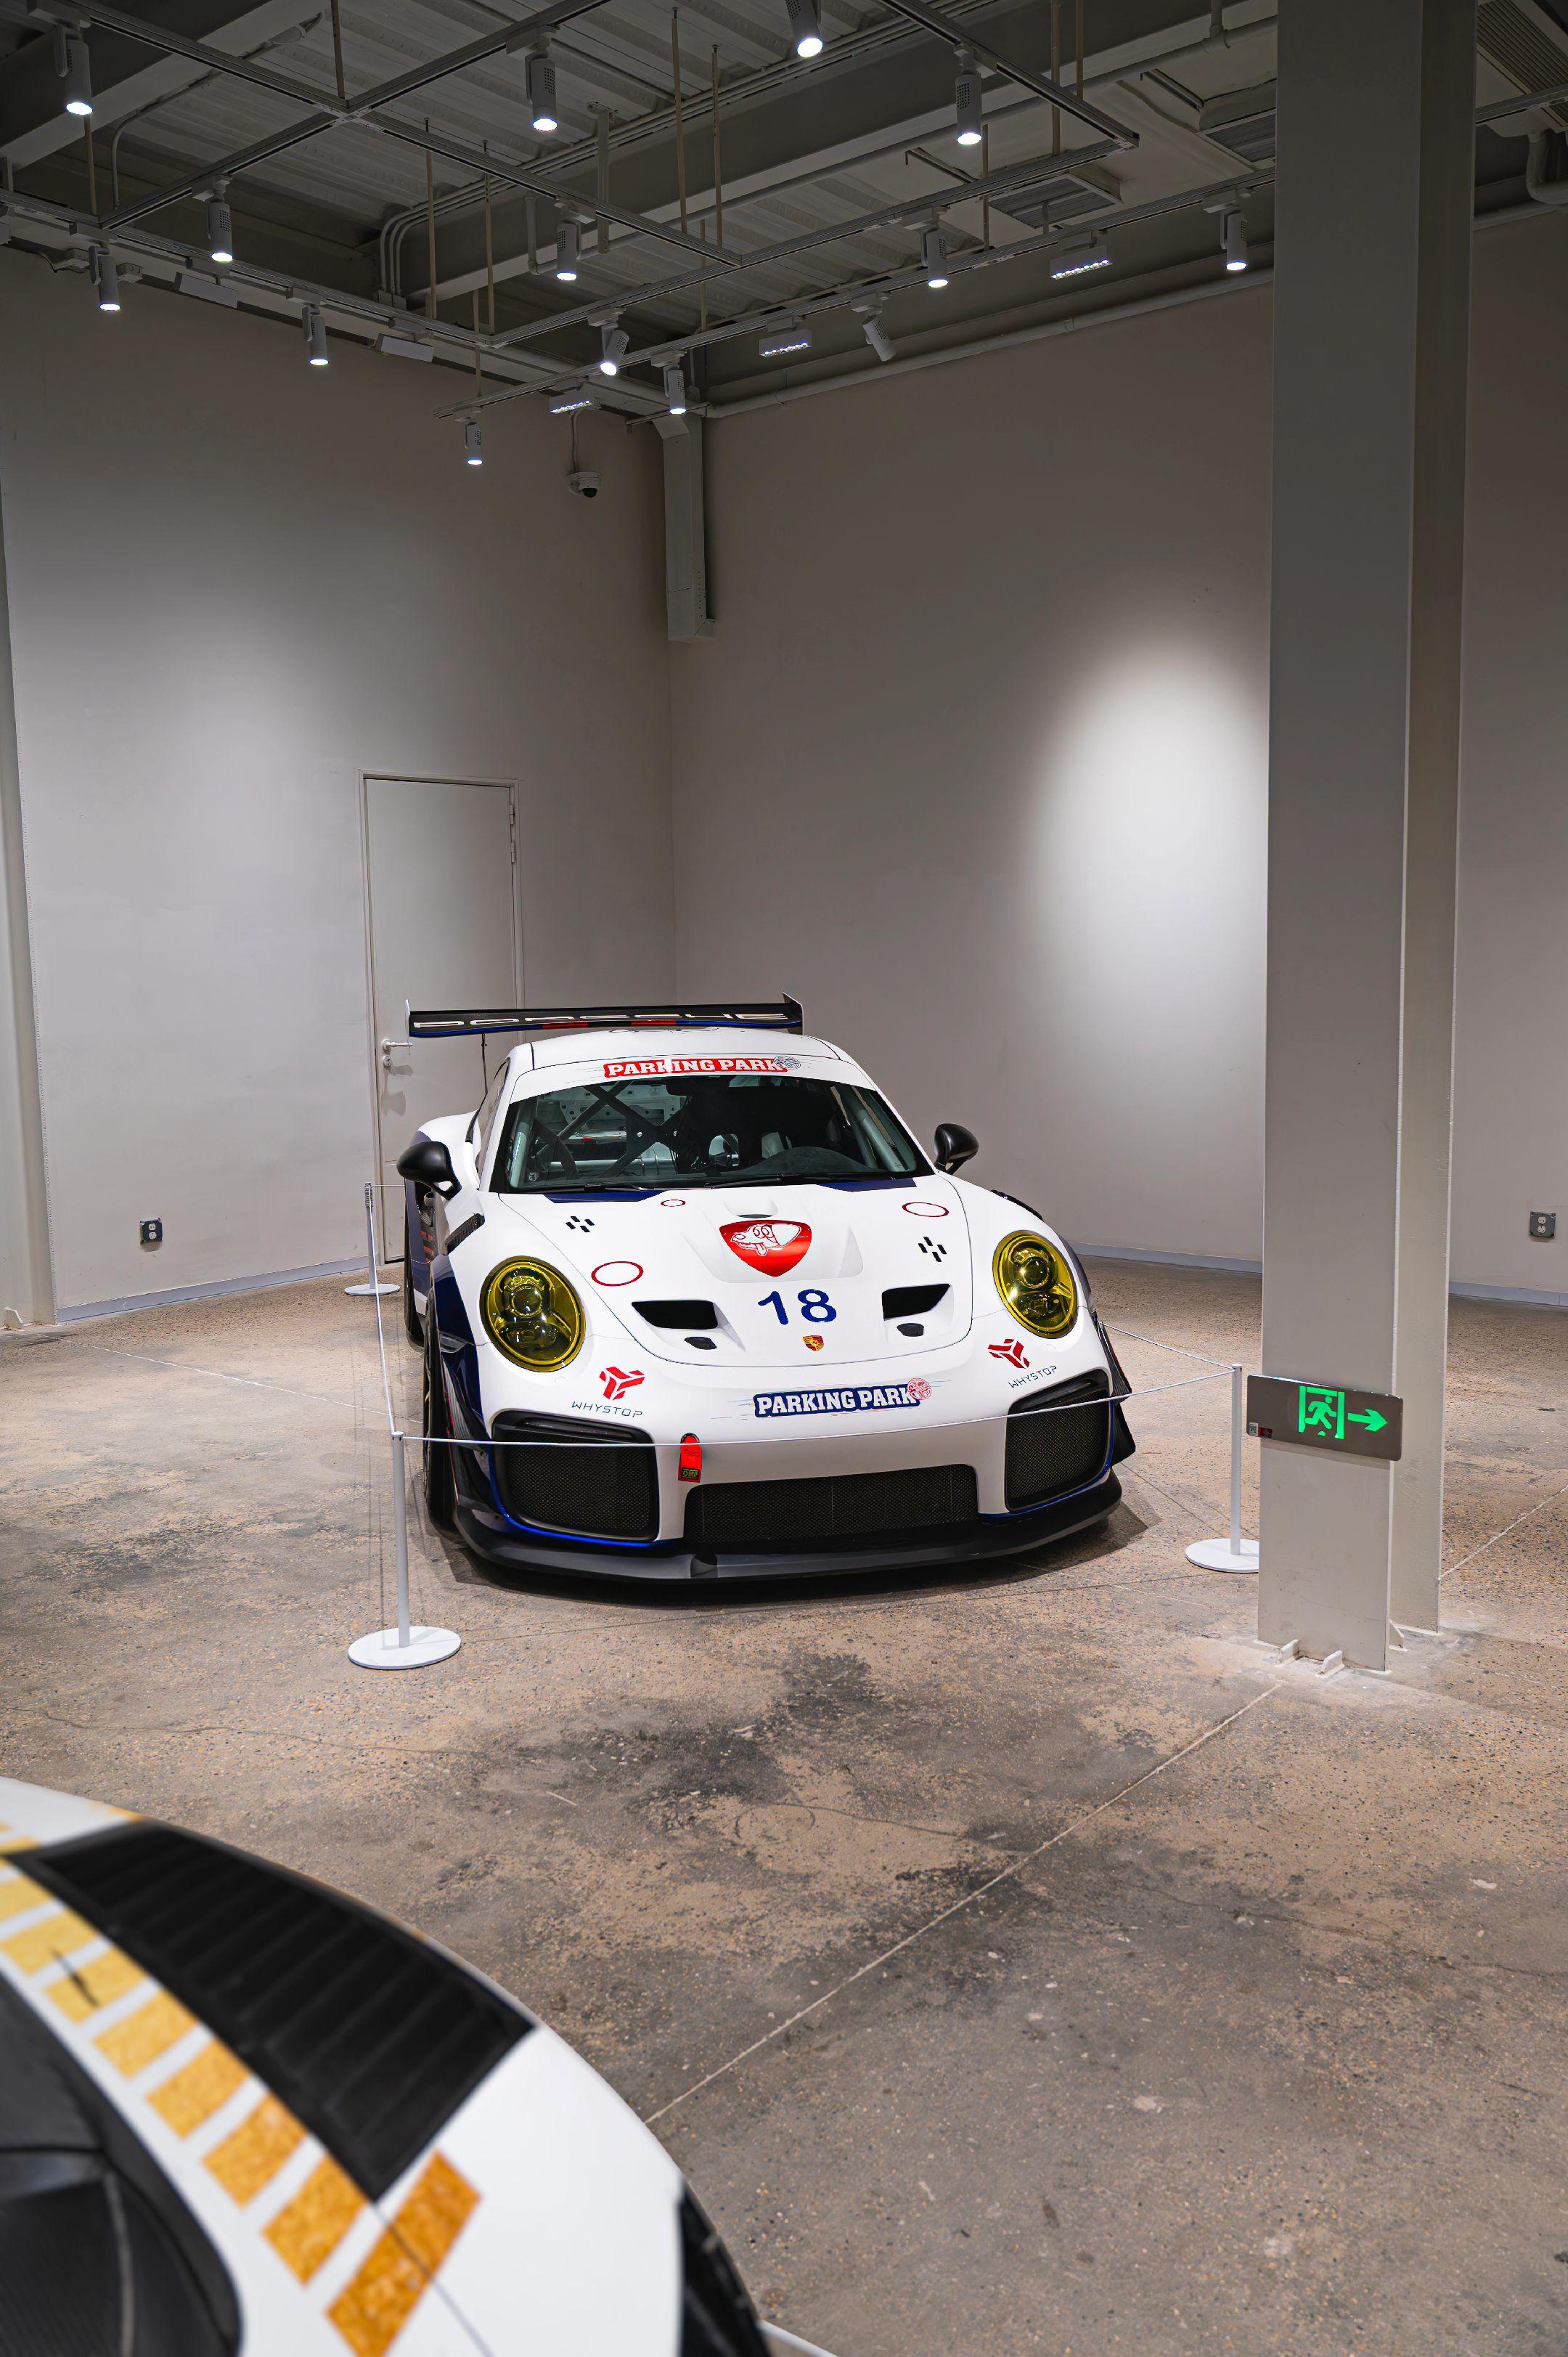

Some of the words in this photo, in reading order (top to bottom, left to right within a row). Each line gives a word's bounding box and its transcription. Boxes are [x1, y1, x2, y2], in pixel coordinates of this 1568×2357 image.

[718, 1059, 783, 1072] PARK
[757, 1288, 837, 1325] 18
[1008, 1365, 1057, 1388] WHYSTOP
[571, 1401, 643, 1417] WHYSTOP
[757, 1391, 855, 1414] PARKING
[858, 1387, 917, 1408] PARK
[682, 1470, 698, 1478] OMP
